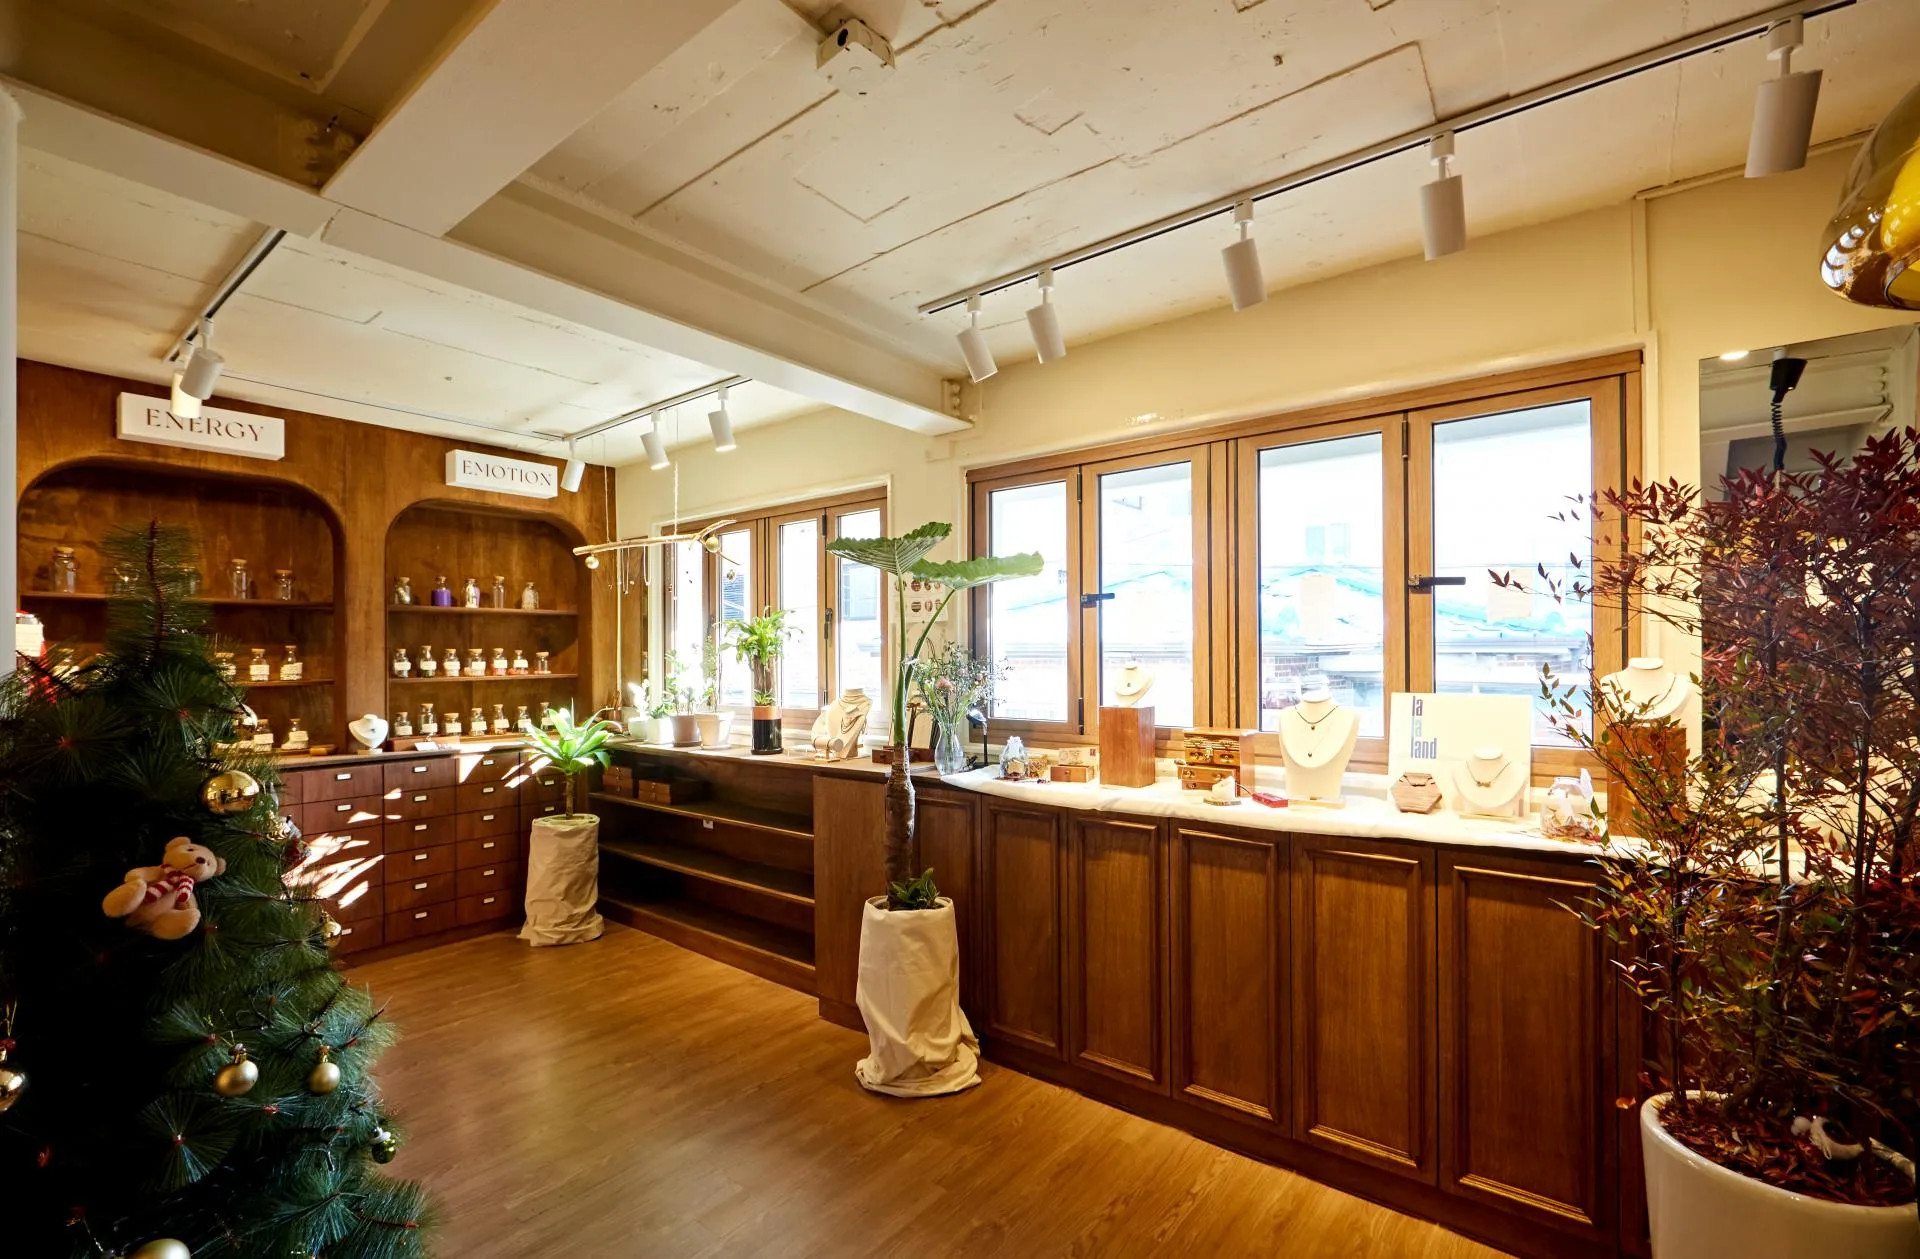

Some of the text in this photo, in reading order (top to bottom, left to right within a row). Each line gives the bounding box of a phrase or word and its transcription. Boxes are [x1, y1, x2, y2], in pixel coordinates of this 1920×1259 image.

[146, 407, 264, 442] ENERGY
[462, 459, 552, 486] EMOTION
[1412, 695, 1424, 717] la
[1410, 737, 1437, 760] land
